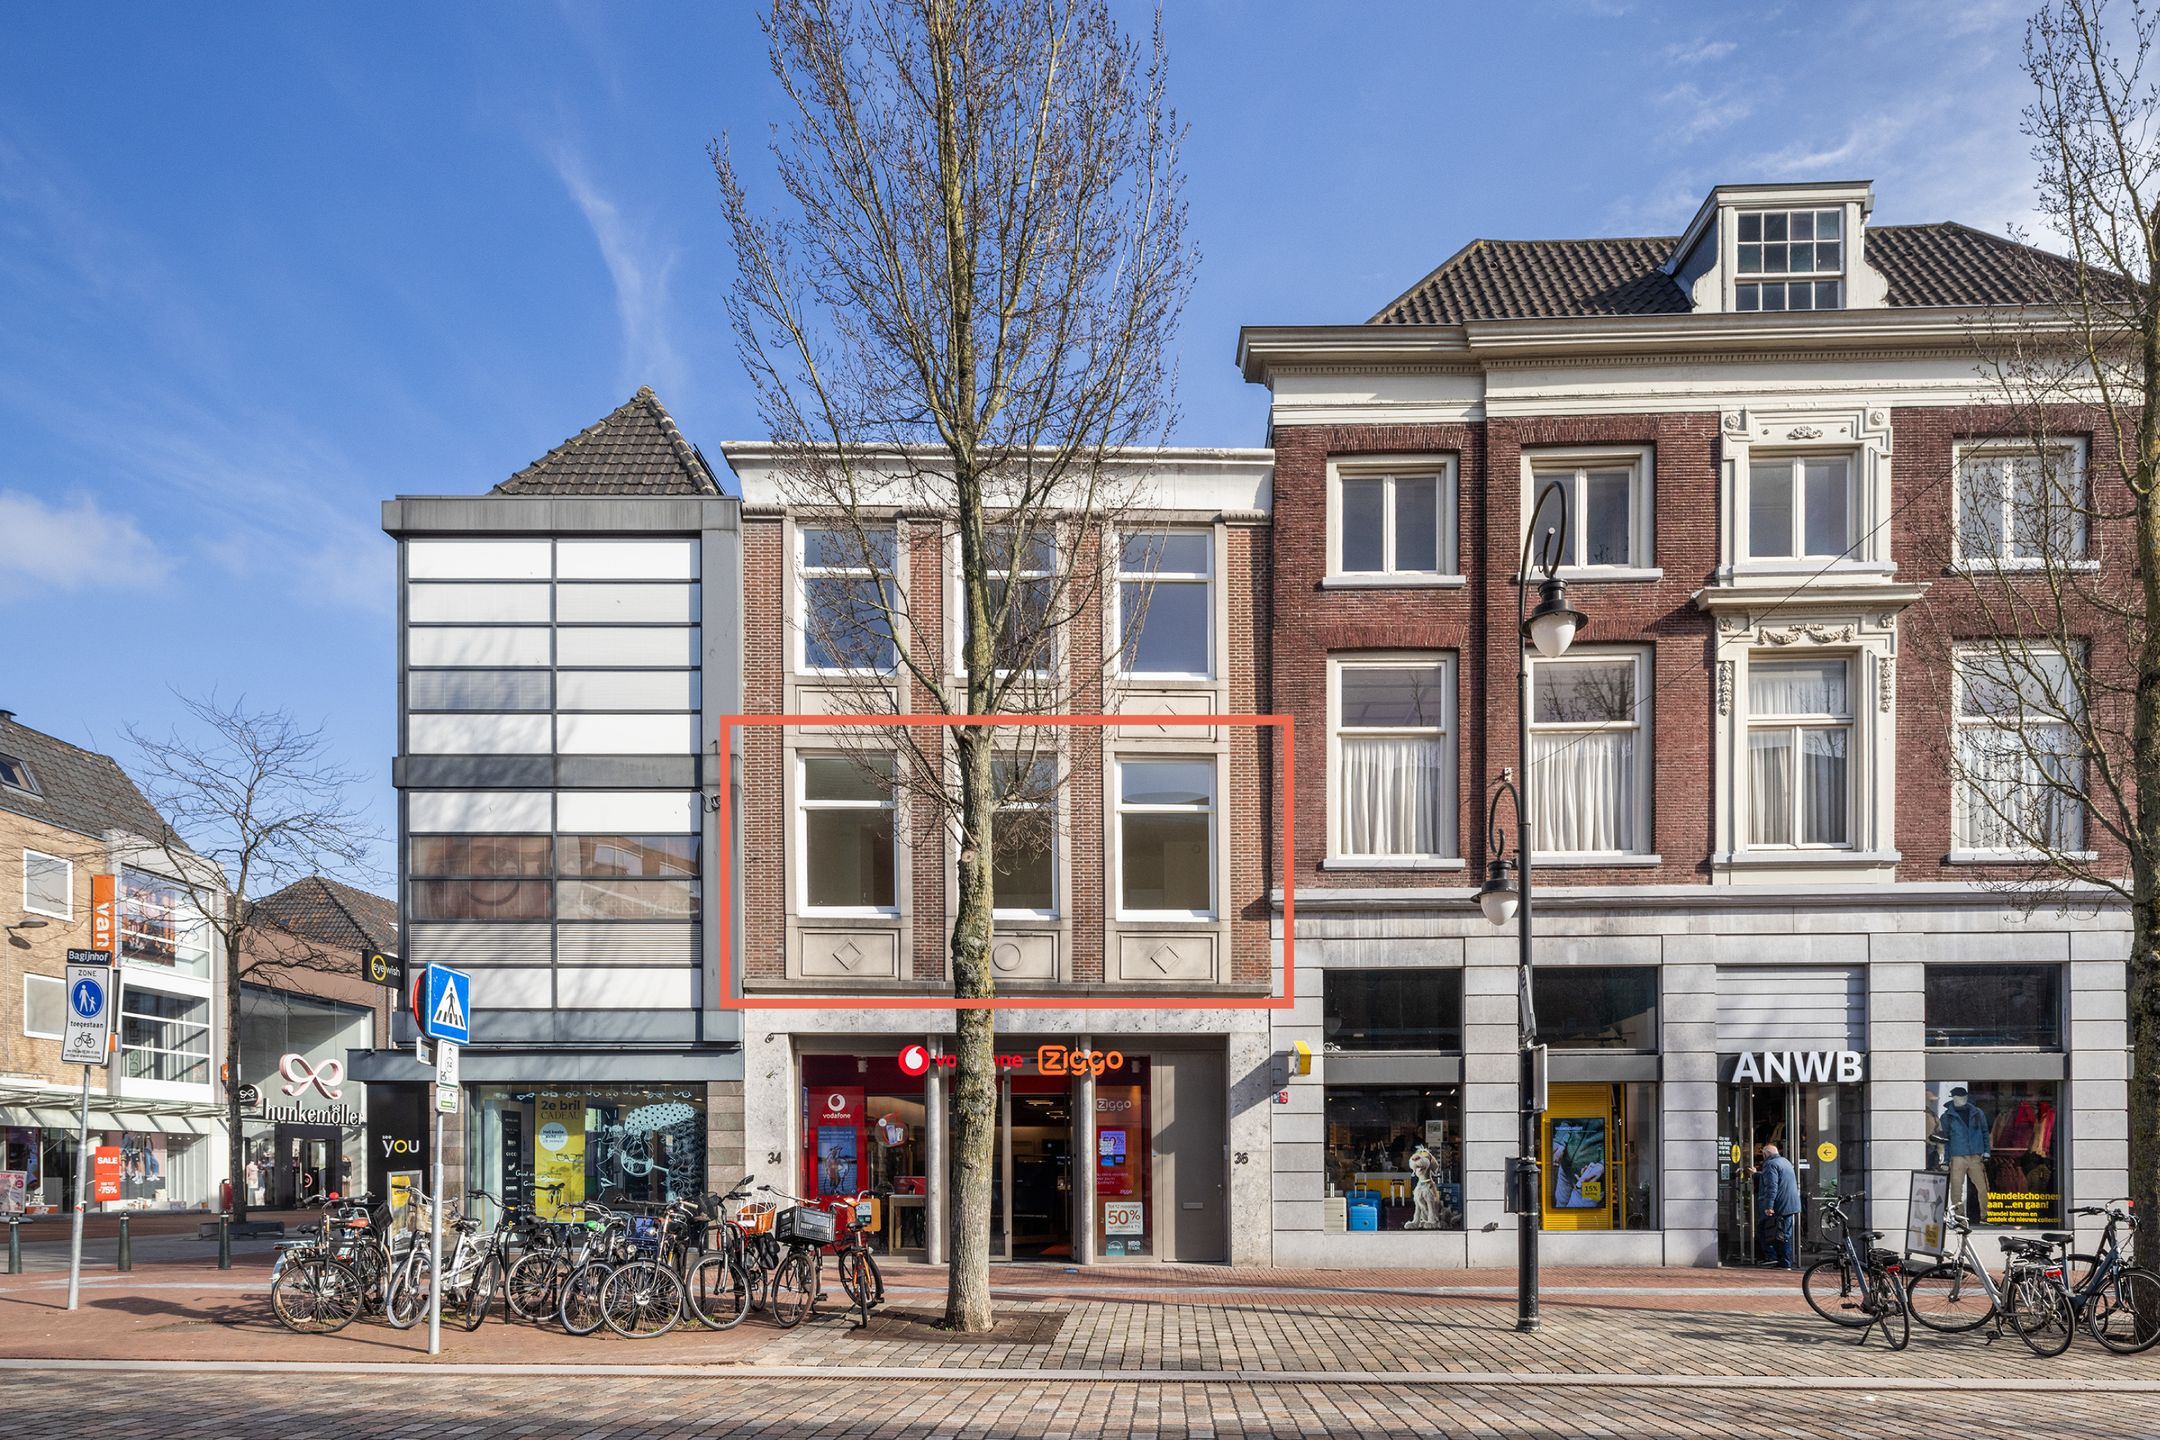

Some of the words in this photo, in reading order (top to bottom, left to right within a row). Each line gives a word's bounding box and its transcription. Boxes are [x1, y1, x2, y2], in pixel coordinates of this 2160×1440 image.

[96, 902, 110, 947] van
[68, 950, 109, 962] Bagijnhof
[78, 969, 97, 977] ZONE
[1731, 1051, 1863, 1083] ANWB
[541, 1101, 556, 1110] 2e
[560, 1100, 580, 1110] bril
[264, 1098, 366, 1125] hunkemöller
[541, 1111, 580, 1119] CADEAU
[382, 1140, 420, 1158] you
[97, 1156, 118, 1164] SALE
[768, 1151, 781, 1164] 34
[1234, 1152, 1248, 1164] 36
[1987, 1192, 2061, 1200] Wandelschoenen
[2025, 1201, 2049, 1210] gaan!
[1108, 1210, 1140, 1225] 50%
